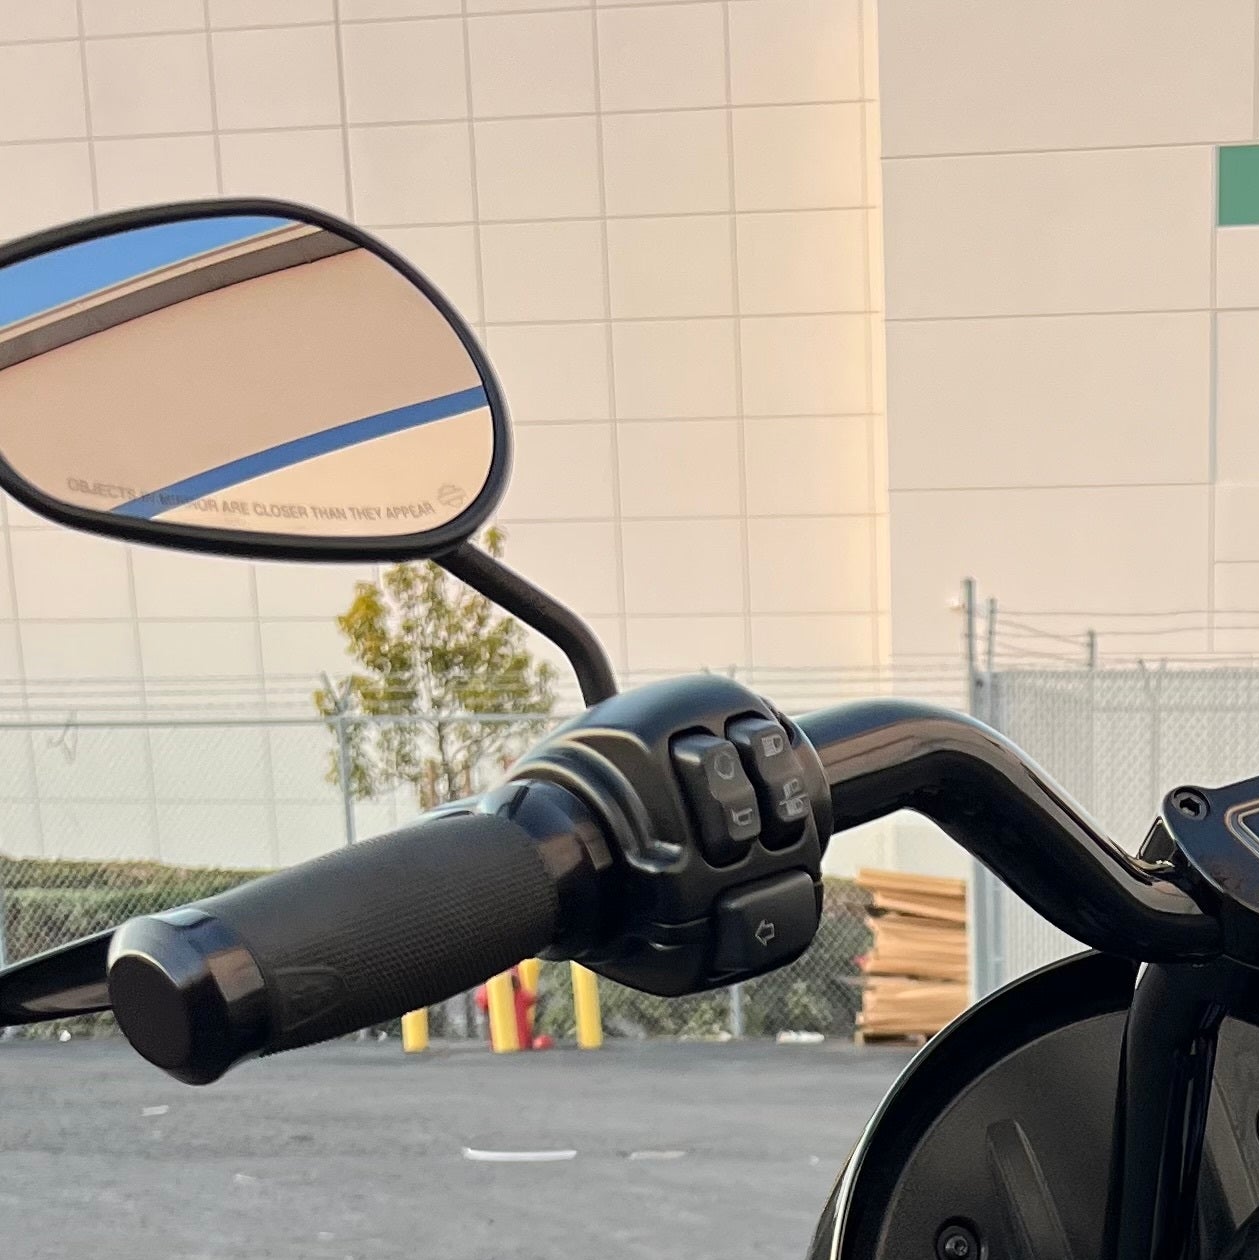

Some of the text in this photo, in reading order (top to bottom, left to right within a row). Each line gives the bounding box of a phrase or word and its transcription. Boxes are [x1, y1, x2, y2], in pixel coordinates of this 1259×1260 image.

[67, 477, 137, 500] OBJECTS
[222, 500, 250, 516] ARE
[252, 502, 308, 519] CLOSER
[310, 505, 348, 521] THAN
[349, 506, 382, 521] THEY
[385, 501, 436, 520] APPEAR
